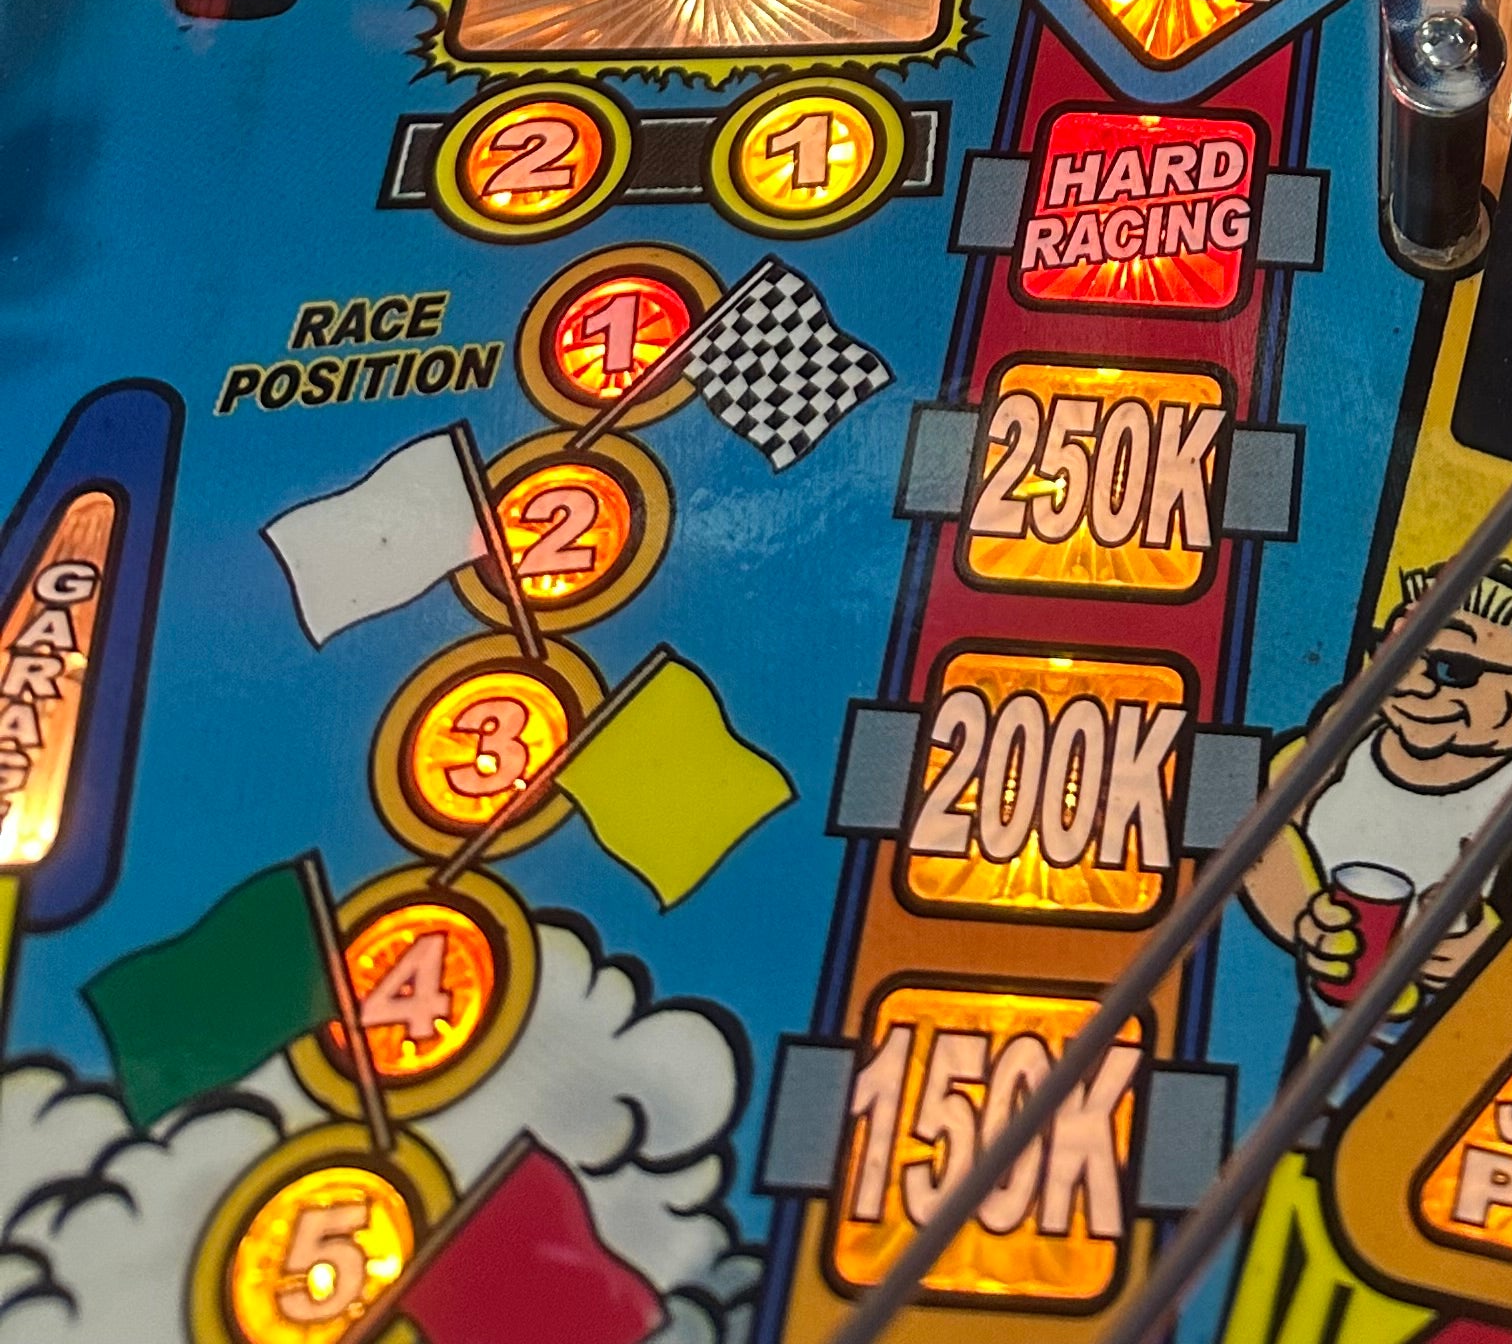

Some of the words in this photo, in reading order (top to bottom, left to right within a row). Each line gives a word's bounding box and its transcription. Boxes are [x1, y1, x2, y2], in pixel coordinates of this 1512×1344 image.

[480, 116, 580, 198] 2
[766, 111, 835, 190] 1
[1047, 138, 1248, 209] HARD
[1019, 199, 1253, 272] RACING
[289, 288, 451, 351] RACE
[582, 292, 642, 375] 1
[212, 340, 503, 417] POSITION
[967, 390, 1229, 551] 250K
[516, 484, 599, 578] 2
[444, 696, 532, 798] 3
[907, 684, 1190, 870] 200K
[360, 929, 454, 1042] 4
[849, 1020, 1146, 1240] 150K
[275, 1186, 372, 1324] 5
